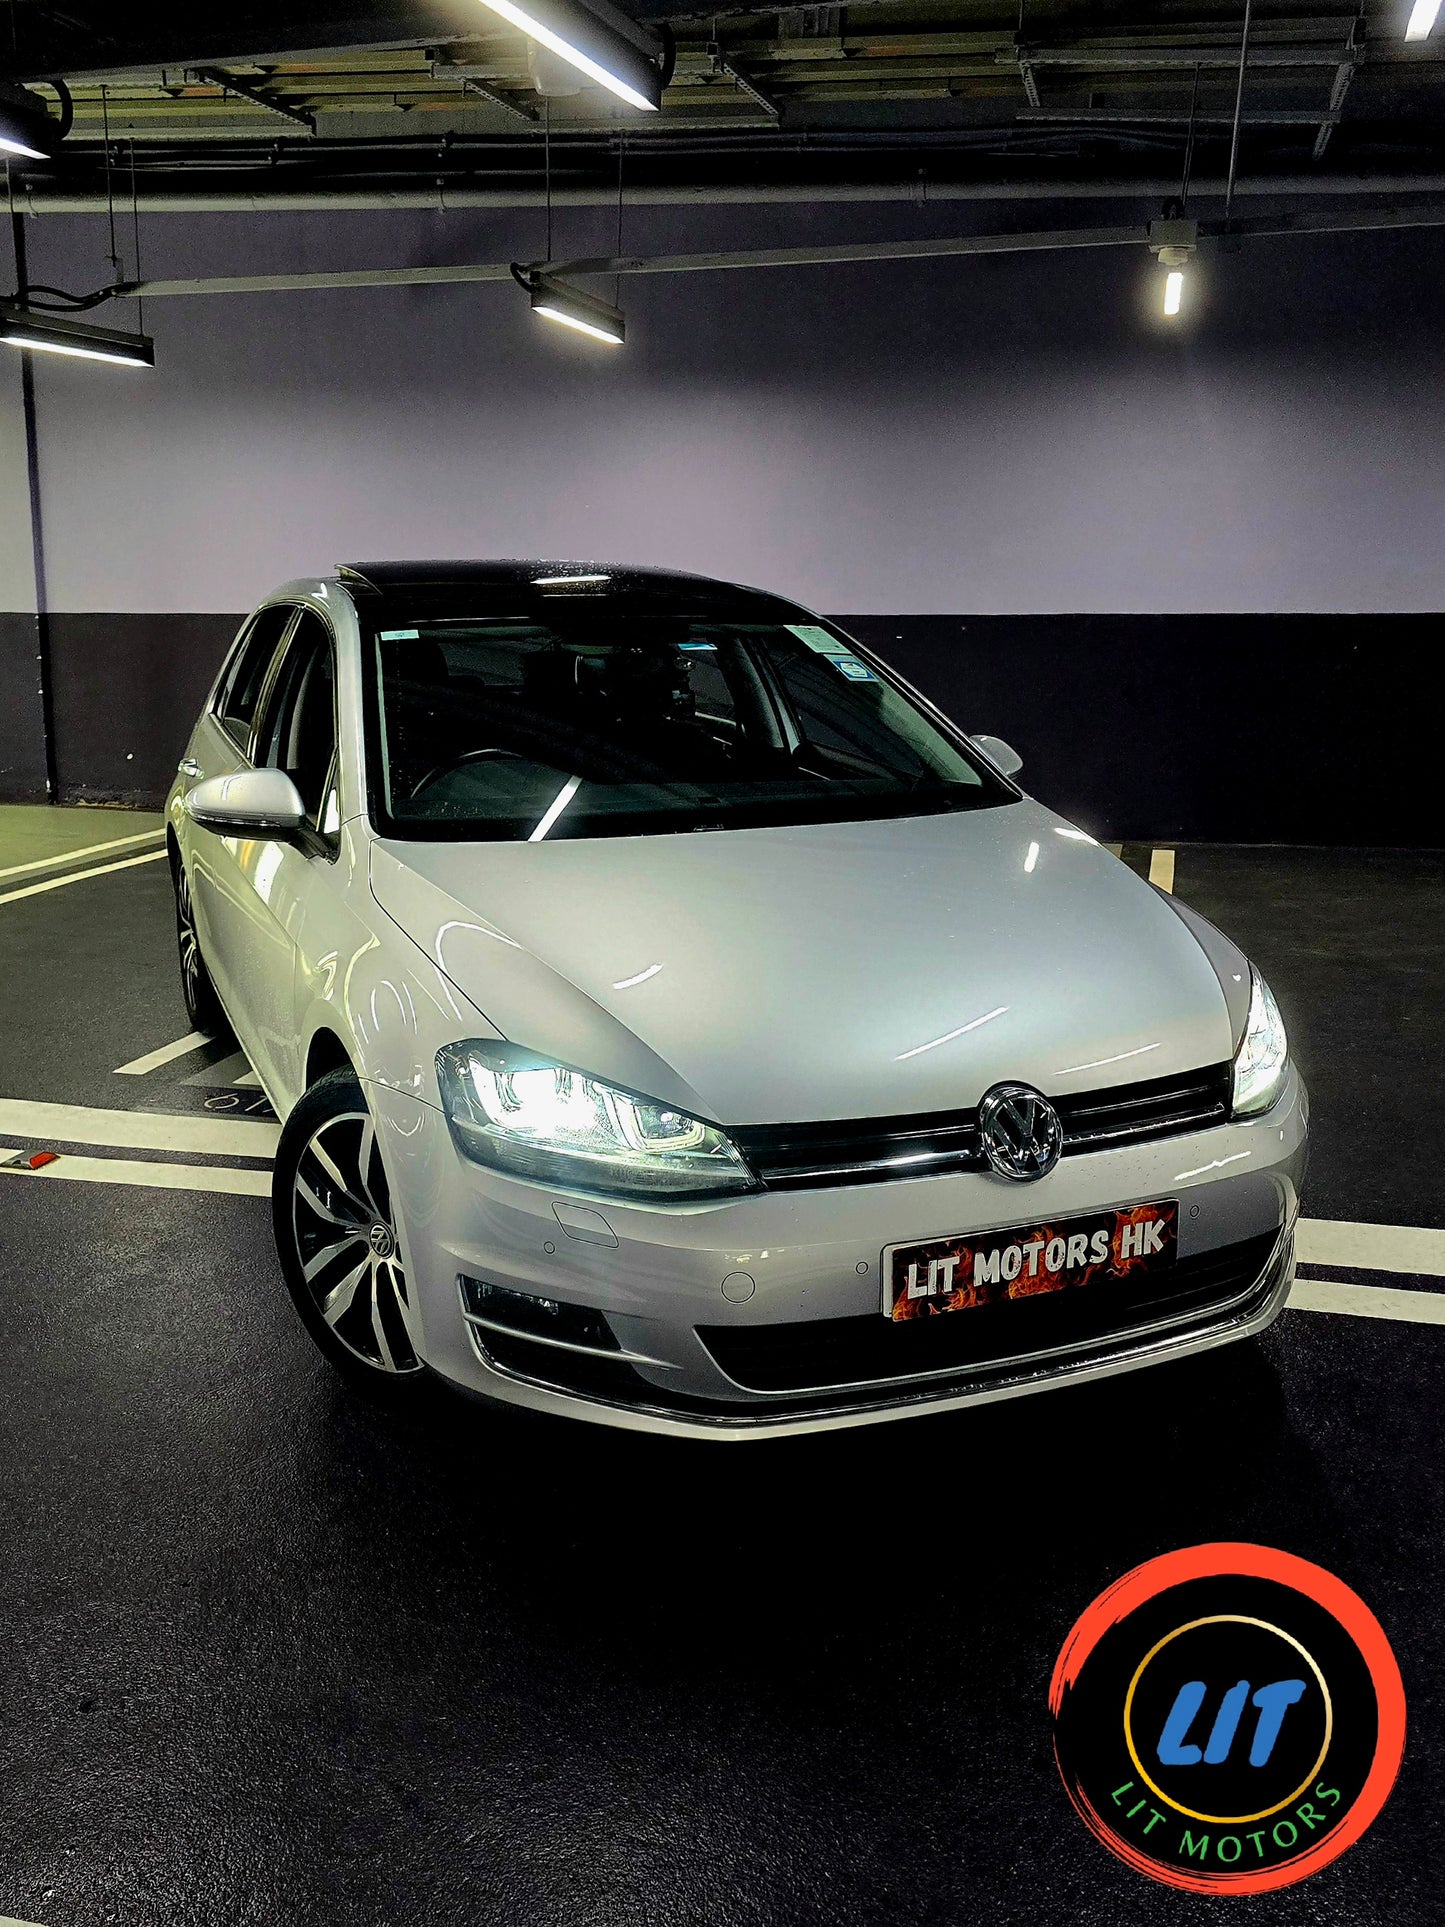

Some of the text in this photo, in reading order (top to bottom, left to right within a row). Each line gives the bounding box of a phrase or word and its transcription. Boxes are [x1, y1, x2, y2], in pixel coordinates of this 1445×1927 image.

[907, 1218, 1166, 1300] LIT MOTORS HK
